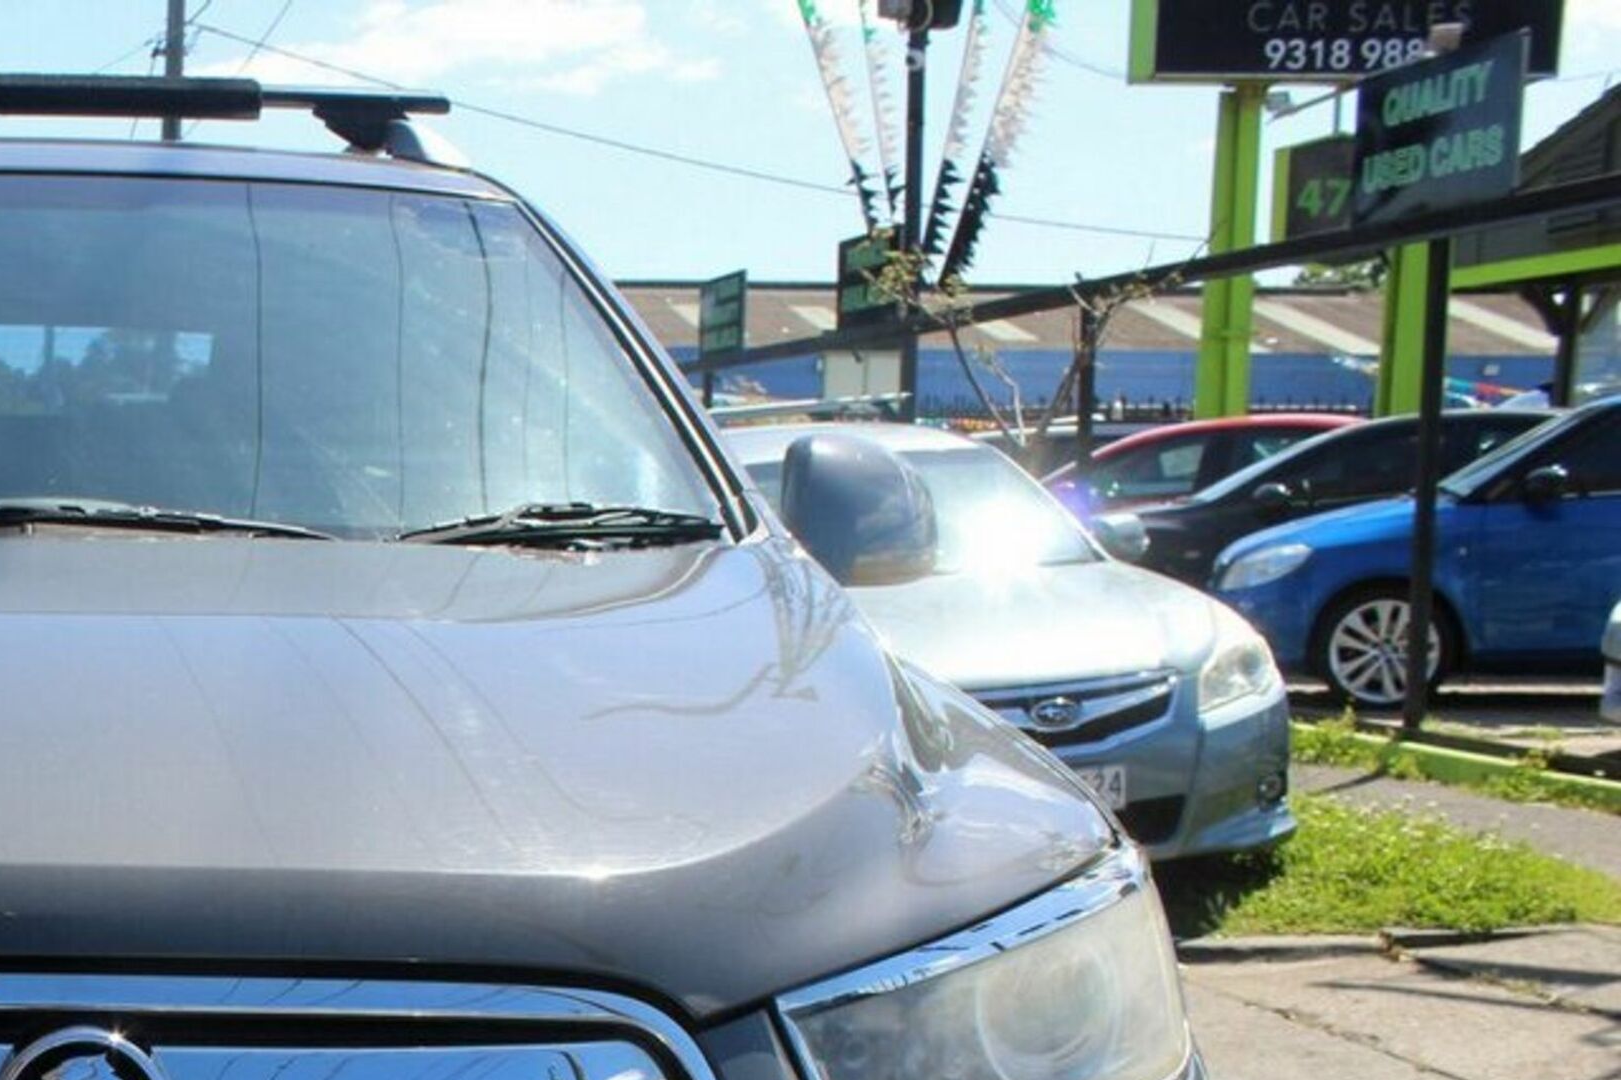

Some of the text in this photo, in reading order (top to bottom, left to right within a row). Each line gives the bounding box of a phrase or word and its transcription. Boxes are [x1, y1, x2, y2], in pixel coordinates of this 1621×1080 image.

[1247, 2, 1471, 32] CAR SALES
[1265, 38, 1424, 69] 9318 988
[1382, 59, 1493, 127] QUALITY
[1361, 123, 1504, 193] USED CARS
